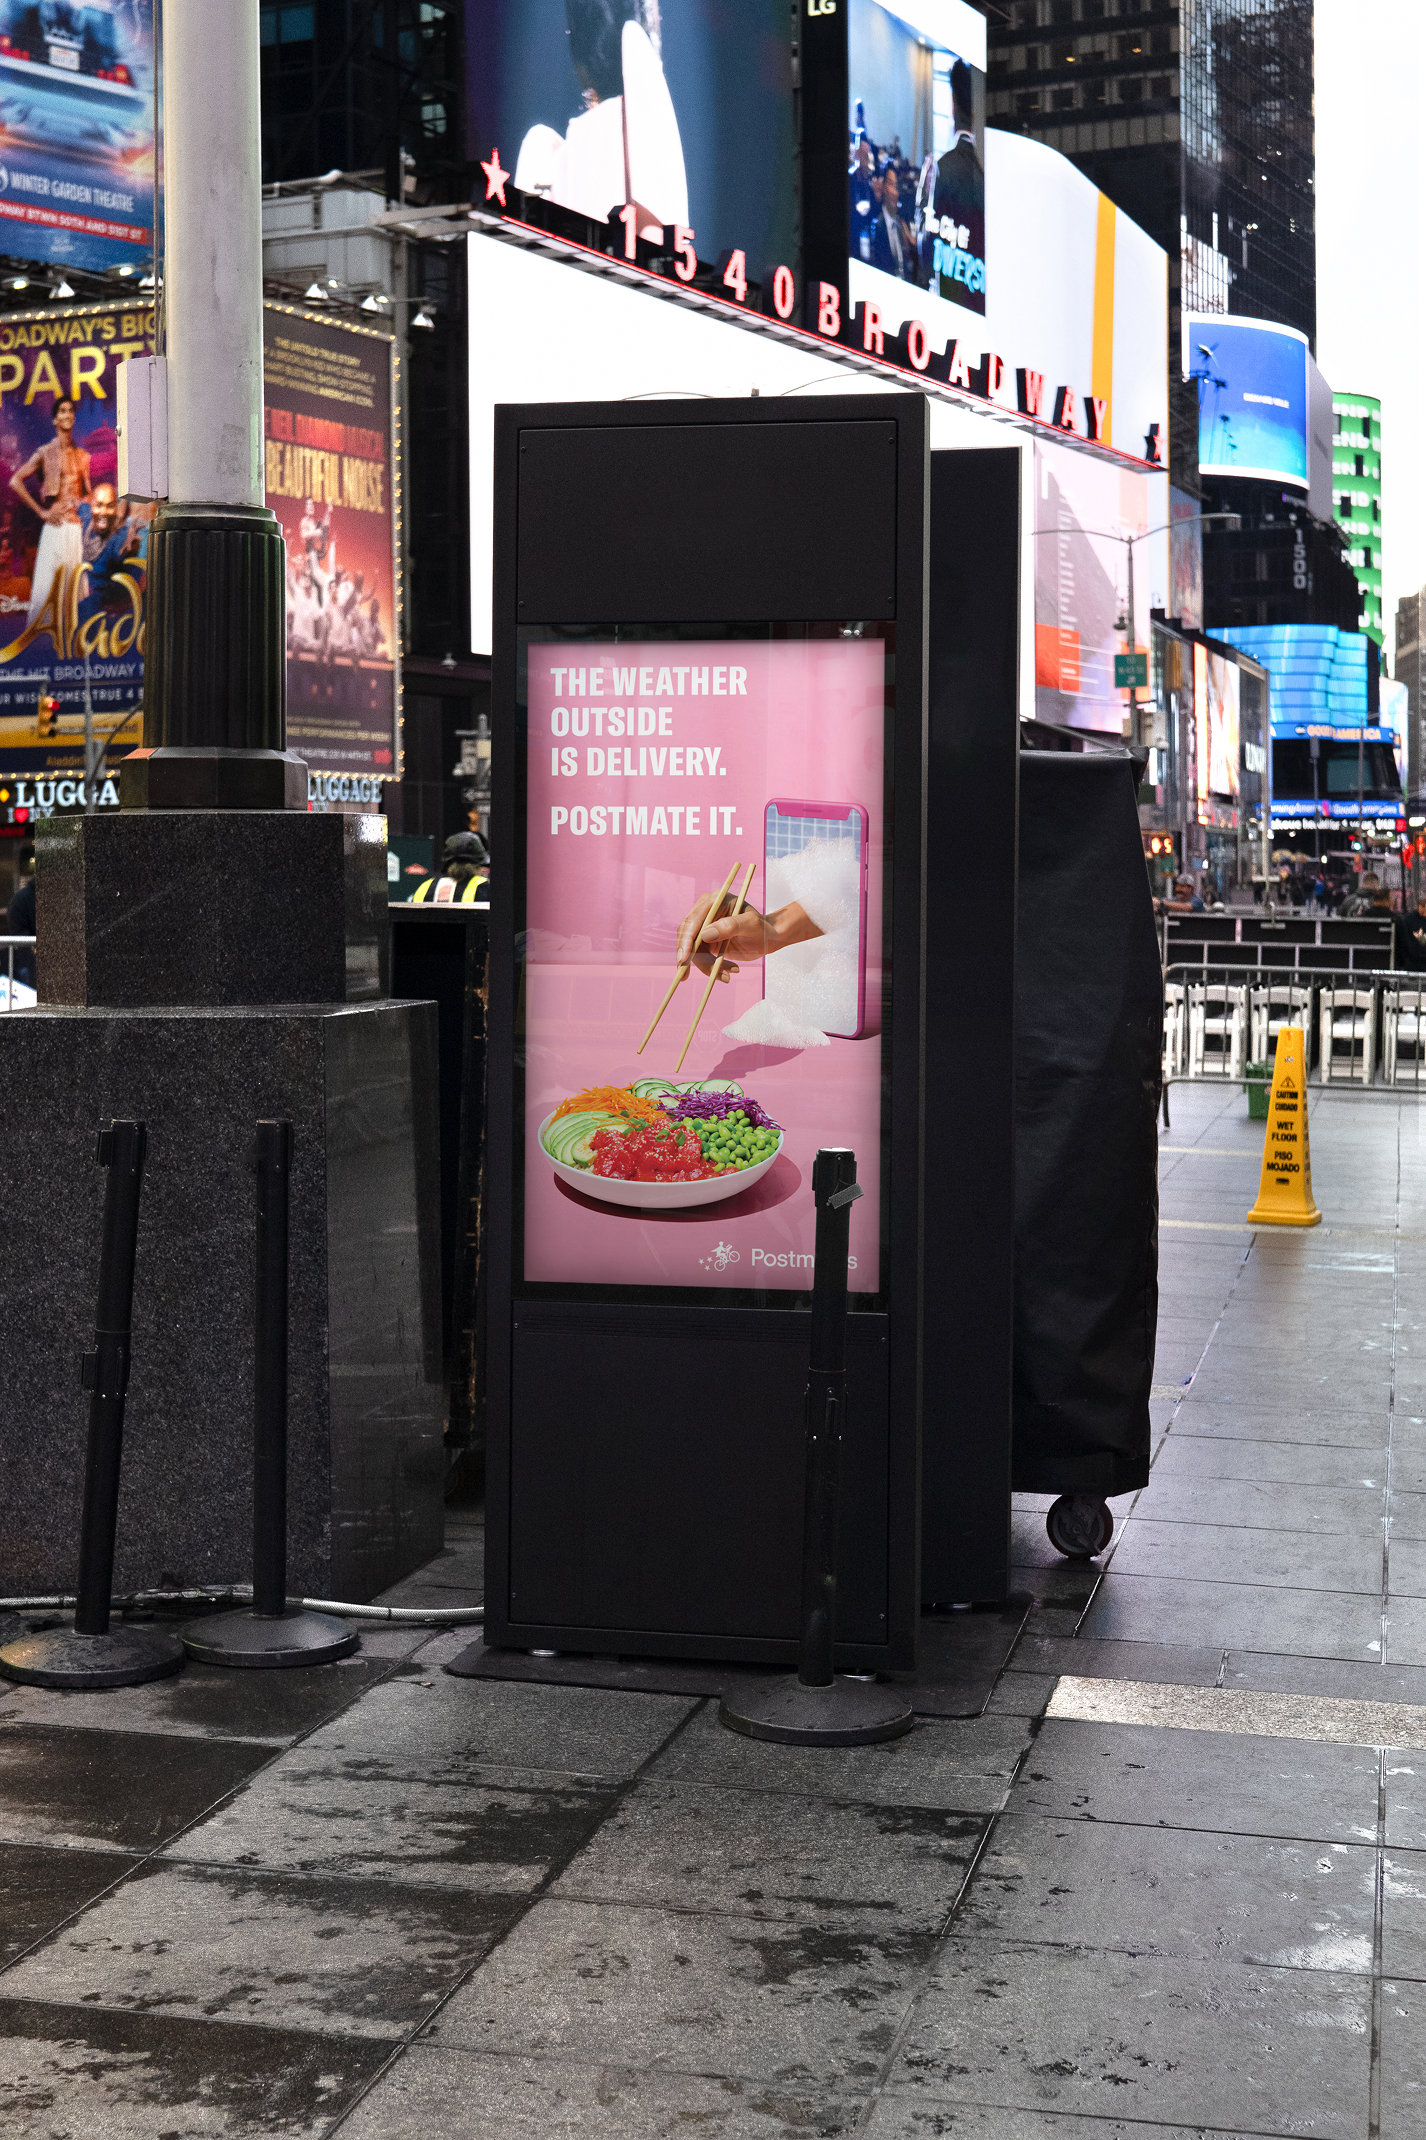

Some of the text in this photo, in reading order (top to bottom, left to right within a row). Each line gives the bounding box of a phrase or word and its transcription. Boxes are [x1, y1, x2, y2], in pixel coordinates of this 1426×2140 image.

[808, 0, 837, 17] LG
[10, 171, 134, 213] WINTER GARDEN THEATRE
[0, 340, 158, 406] PART
[818, 281, 1108, 441] BROADWAY
[265, 439, 386, 514] BEAUTIFUL NOISE
[1293, 528, 1307, 590] 1500
[54, 662, 137, 681] BROADWAY
[551, 666, 748, 696] THE WEATHER
[14, 691, 41, 704] WIS
[92, 686, 122, 702] TRUE
[551, 706, 673, 737] OUTSIDE
[551, 746, 727, 777] IS DELIVERY.
[15, 780, 120, 808] LUGGA
[308, 777, 383, 804] LUGGAGE
[551, 805, 743, 836] POSTMATE IT.
[1275, 1102, 1298, 1111] CUIDADO
[1276, 1090, 1299, 1099] CAUTION
[1271, 1133, 1298, 1142] FLOOR
[1276, 1121, 1294, 1131] WET
[1266, 1162, 1300, 1173] MOJADO
[1274, 1151, 1293, 1161] PISO
[751, 1248, 858, 1270] Postms
